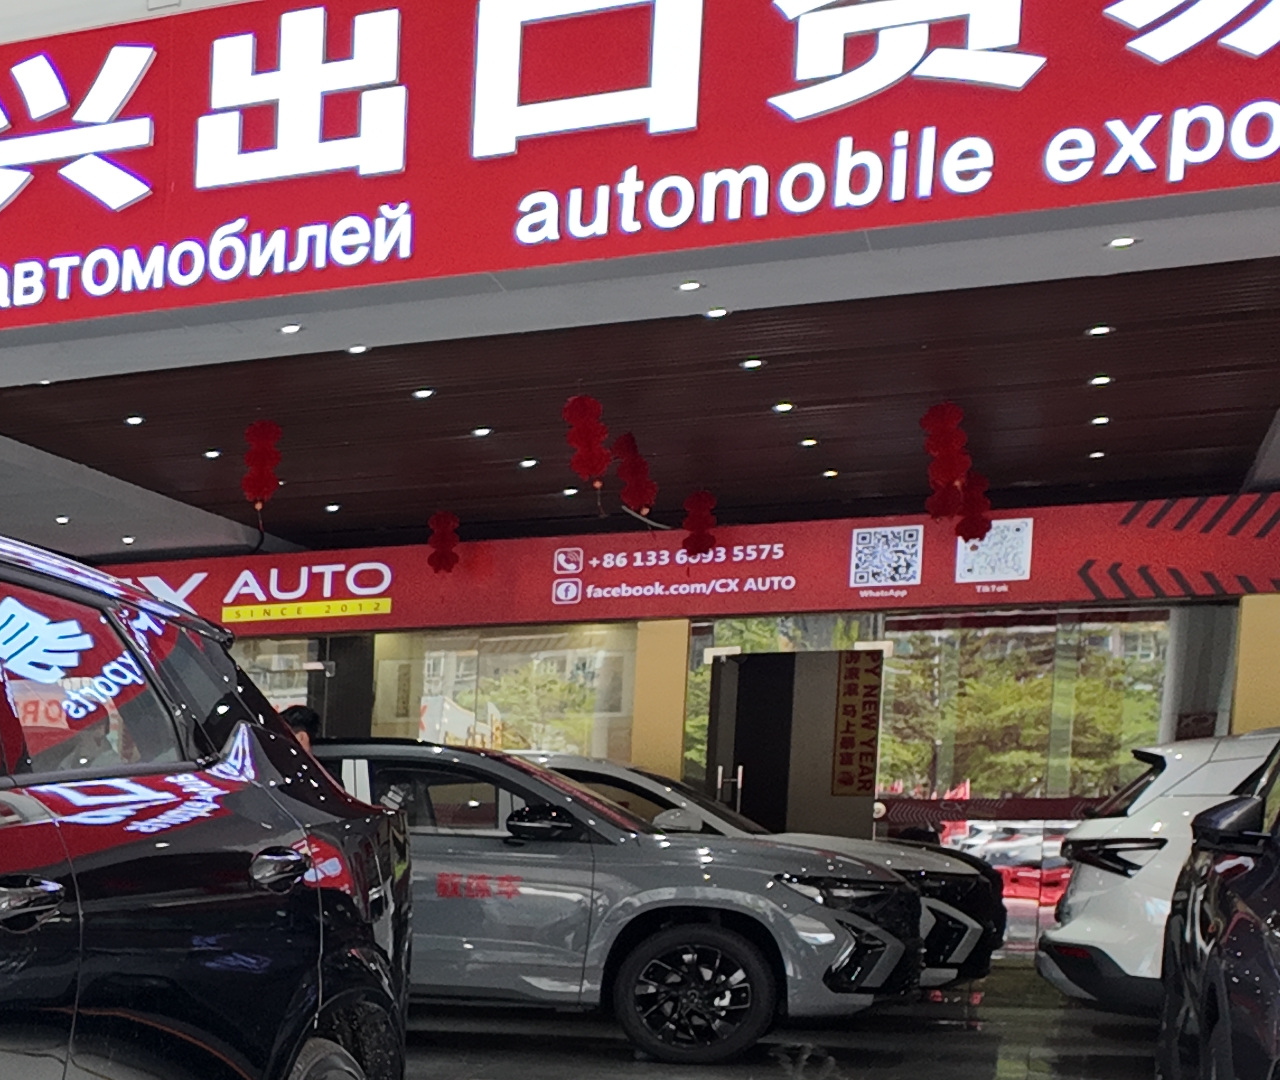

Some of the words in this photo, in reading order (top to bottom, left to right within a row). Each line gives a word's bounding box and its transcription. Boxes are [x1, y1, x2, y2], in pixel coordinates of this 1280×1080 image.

[514, 126, 995, 246] automobile
[1043, 99, 1280, 184] expo
[588, 551, 628, 570] +86
[633, 548, 670, 567] 133
[732, 543, 785, 562] 5575
[222, 561, 393, 605] AUTO
[586, 577, 739, 600] facebook.com/CX
[743, 576, 797, 592] AUTO
[858, 587, 908, 600] WhatsApp
[234, 606, 304, 620] SINCE
[324, 601, 383, 614] 2012
[861, 684, 880, 731] NEW
[856, 736, 877, 792] YEAR
